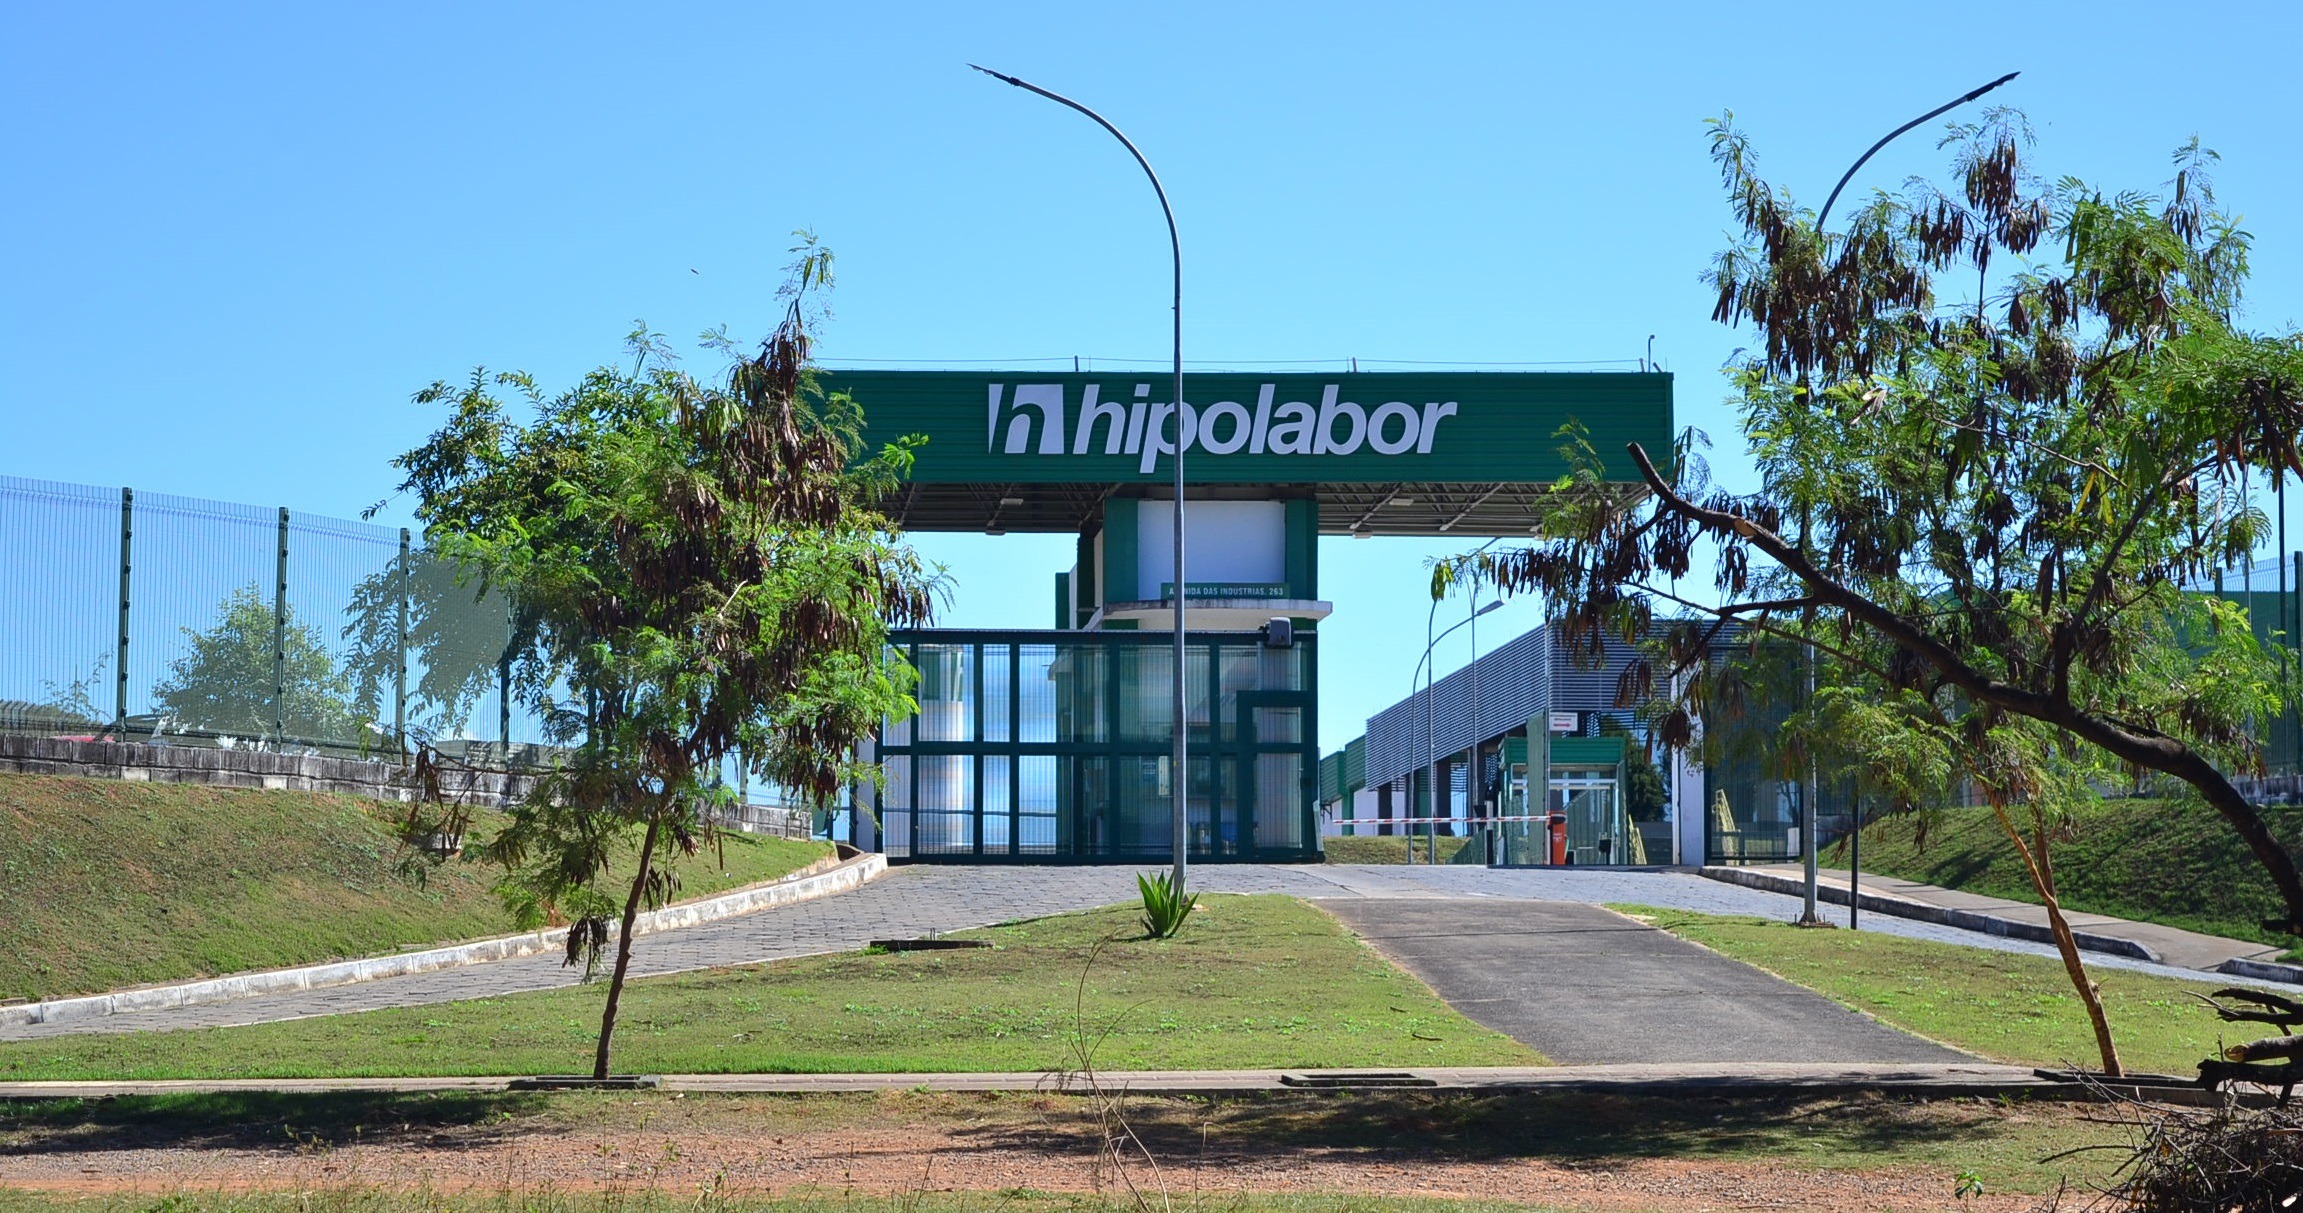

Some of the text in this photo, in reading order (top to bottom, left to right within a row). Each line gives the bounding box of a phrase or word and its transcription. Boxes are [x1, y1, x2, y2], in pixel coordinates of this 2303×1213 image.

[1073, 384, 1458, 474] hipolabor
[1168, 587, 1201, 595] ANIDA
[1203, 587, 1218, 595] DAS
[1269, 587, 1284, 595] 263
